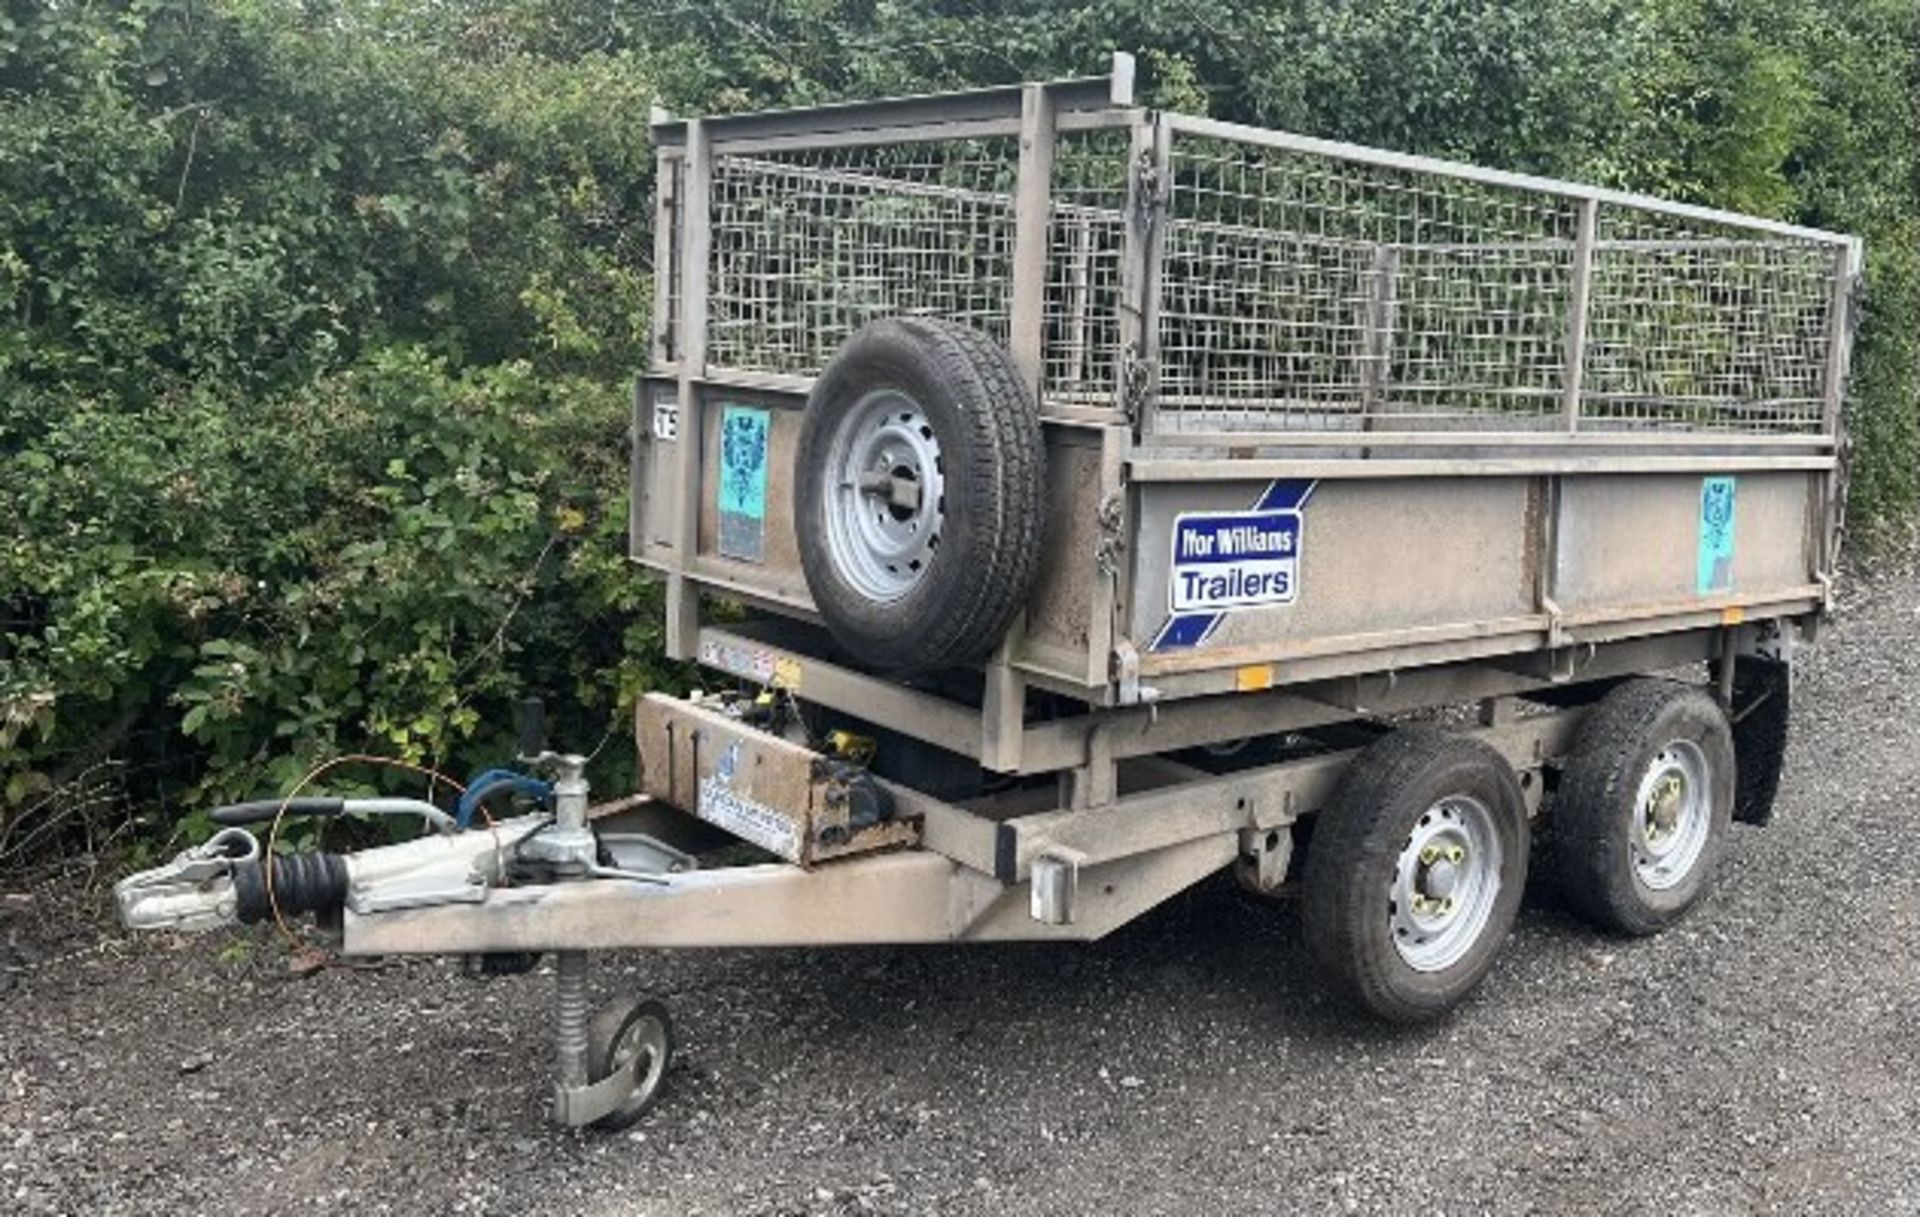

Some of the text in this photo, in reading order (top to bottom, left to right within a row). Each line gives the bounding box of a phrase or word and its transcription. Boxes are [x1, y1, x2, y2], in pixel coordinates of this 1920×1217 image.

[1182, 525, 1293, 558] Ifor Williams
[1181, 568, 1287, 601] Trailers
